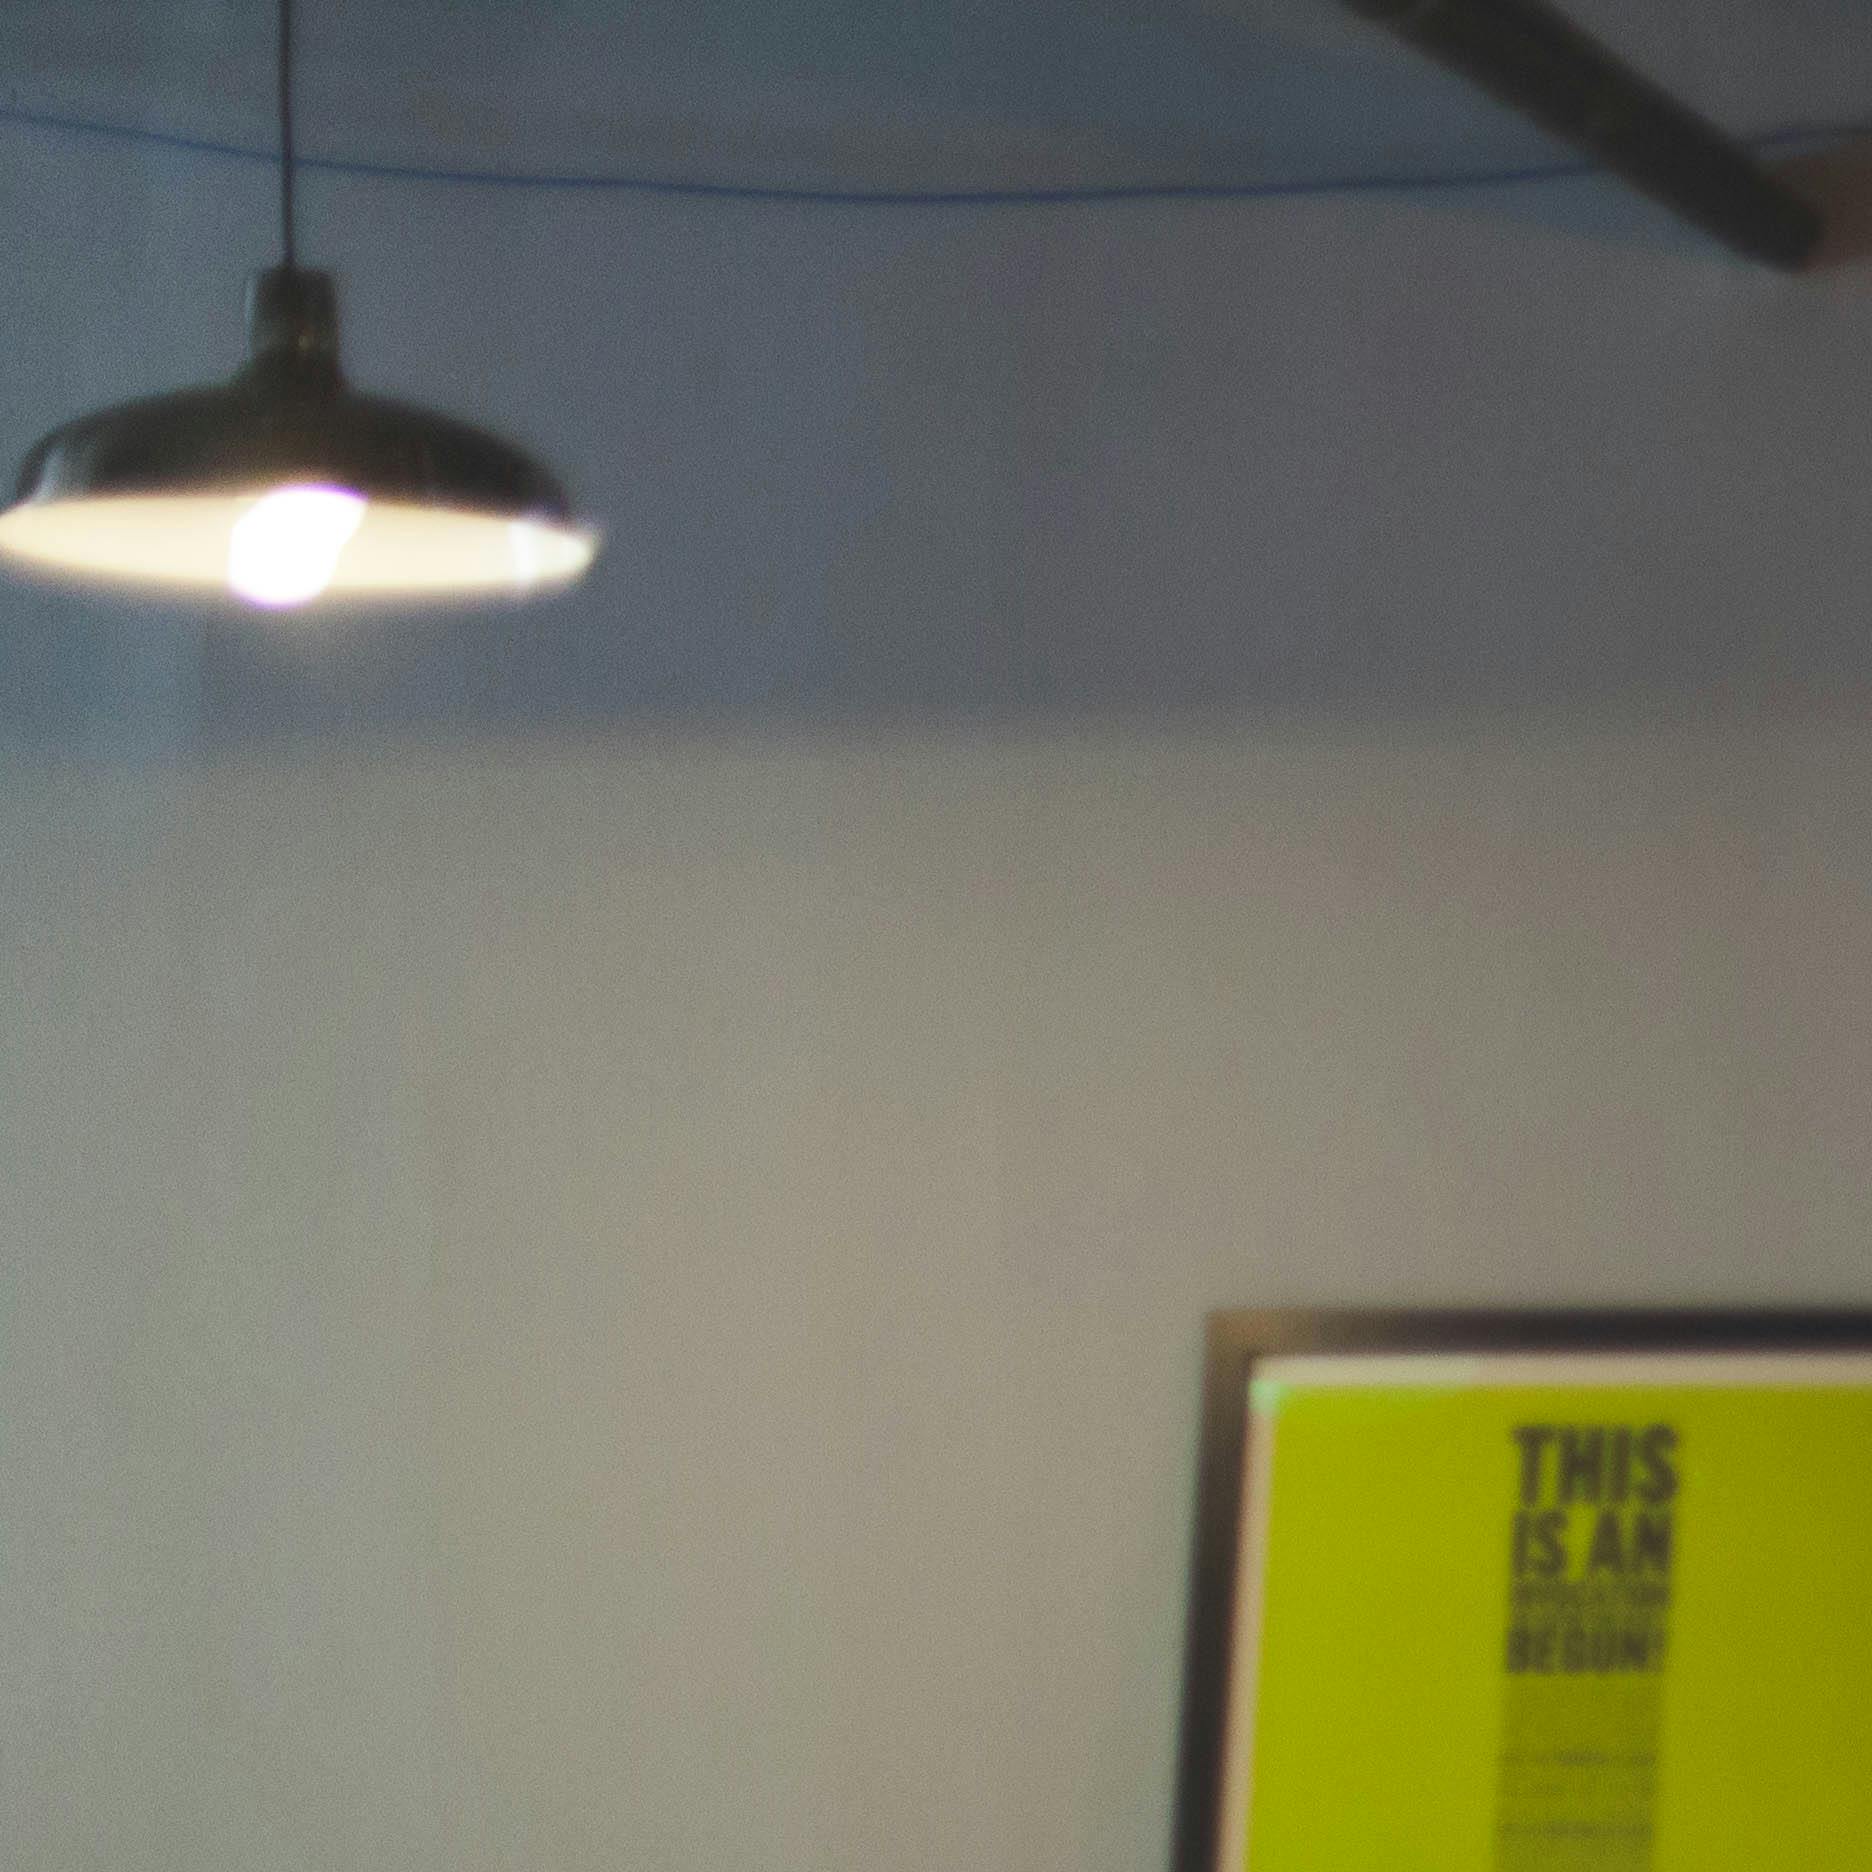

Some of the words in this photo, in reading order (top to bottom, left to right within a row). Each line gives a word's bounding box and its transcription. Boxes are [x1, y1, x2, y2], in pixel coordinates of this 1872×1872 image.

[1511, 1425, 1680, 1505] THIS
[1511, 1508, 1570, 1577] IS
[1586, 1508, 1672, 1577] AN
